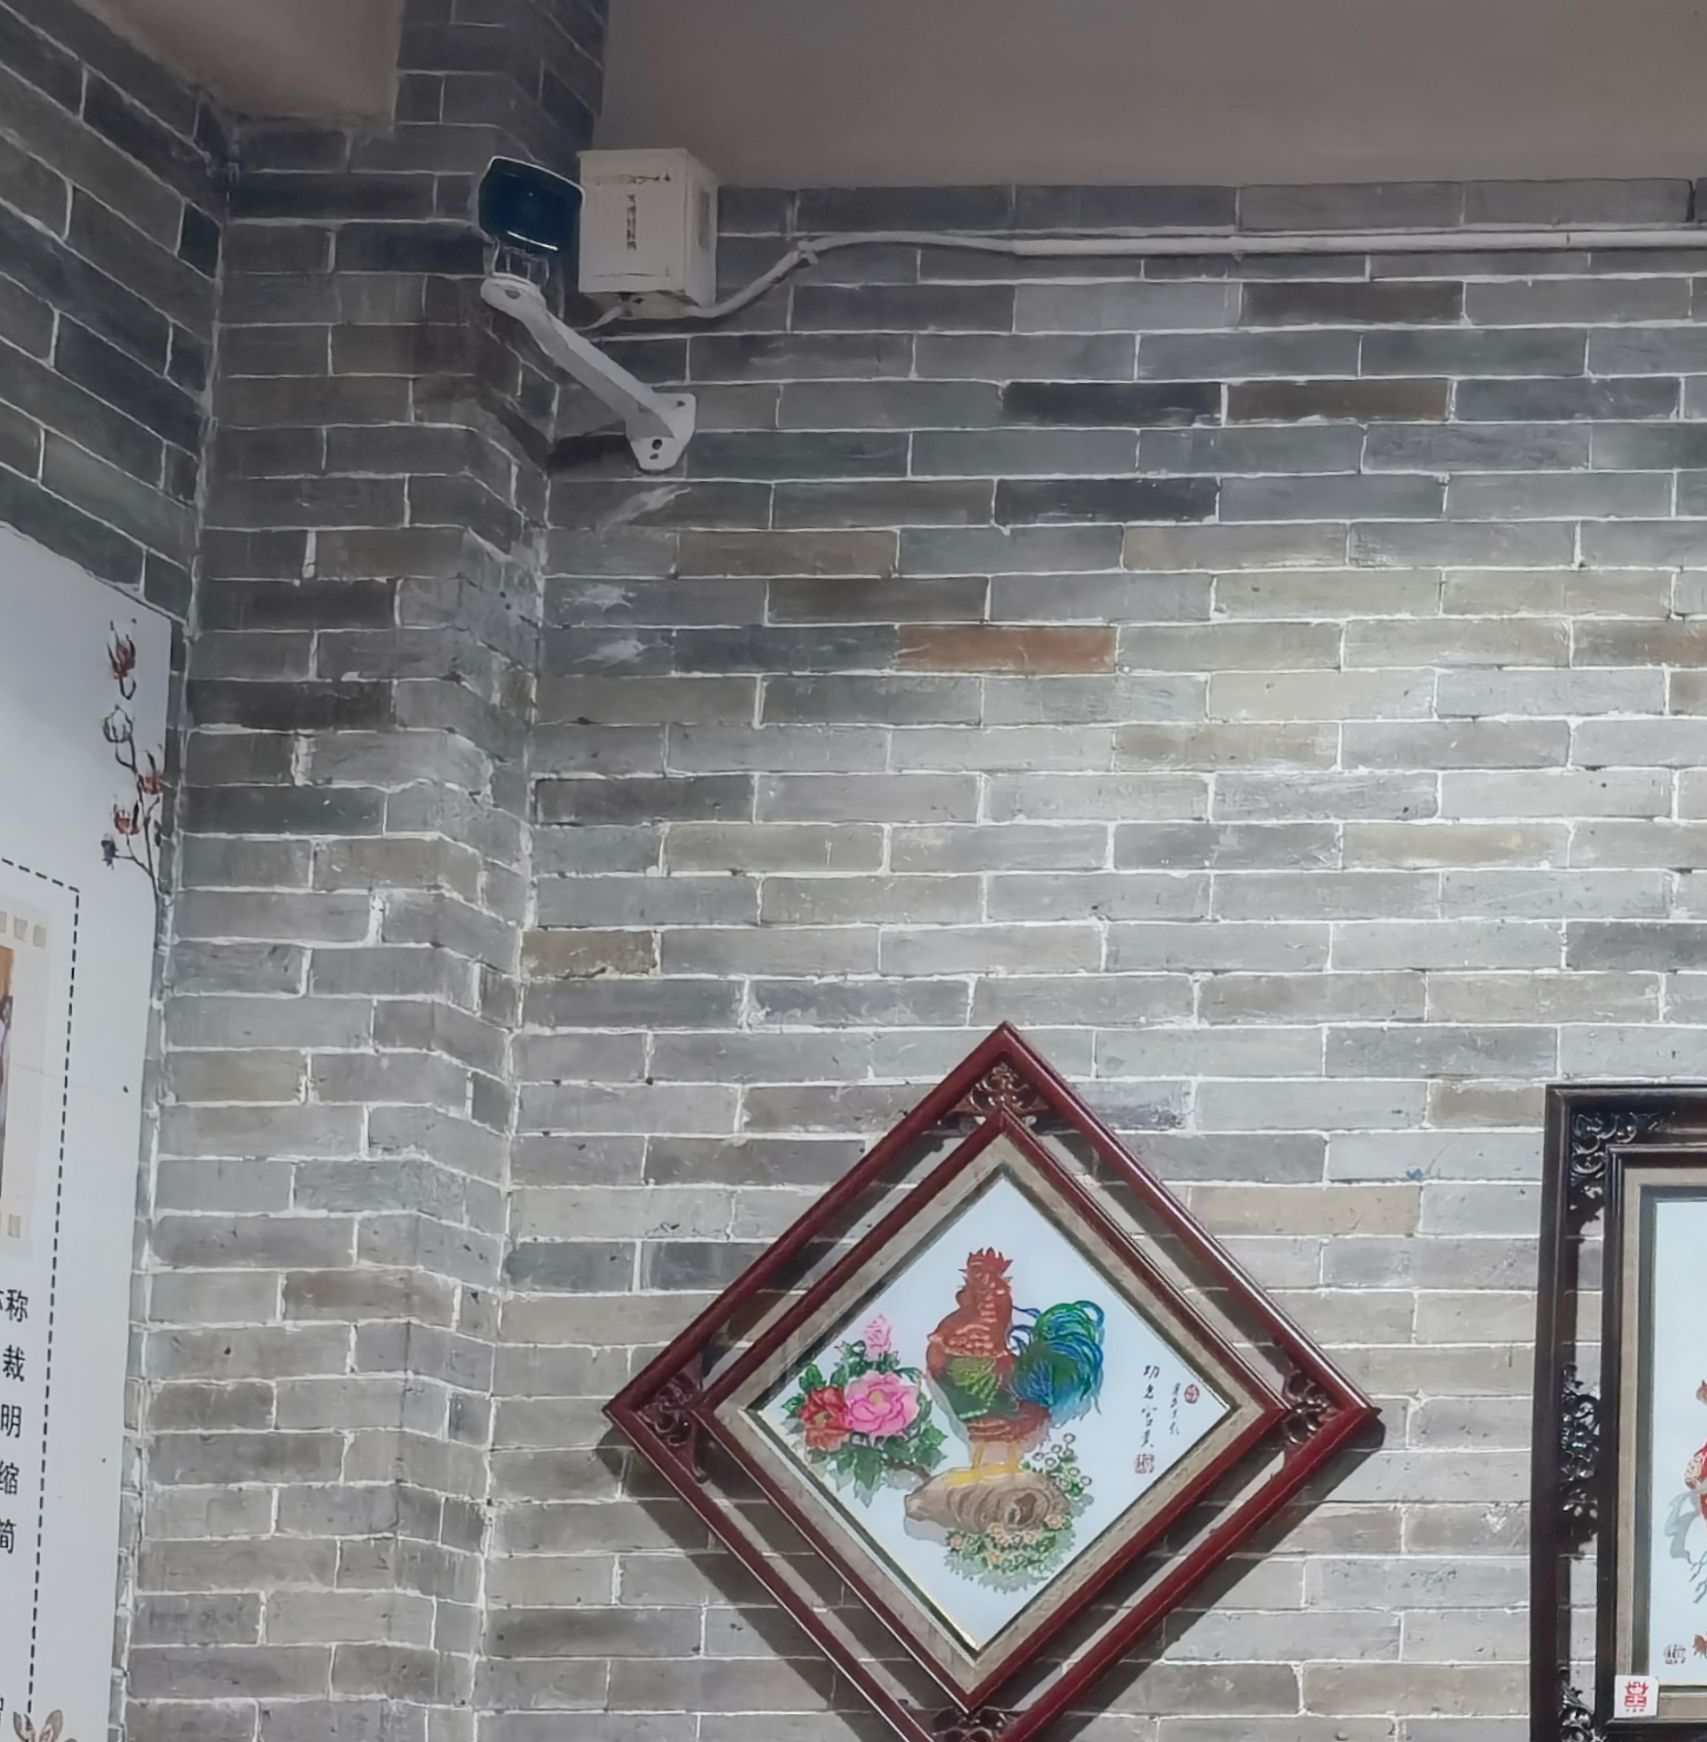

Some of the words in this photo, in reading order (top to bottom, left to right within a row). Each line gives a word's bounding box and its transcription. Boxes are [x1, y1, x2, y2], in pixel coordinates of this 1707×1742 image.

[0, 1289, 28, 1323] 称
[2, 1344, 26, 1382] 裁
[0, 1403, 22, 1438] 明
